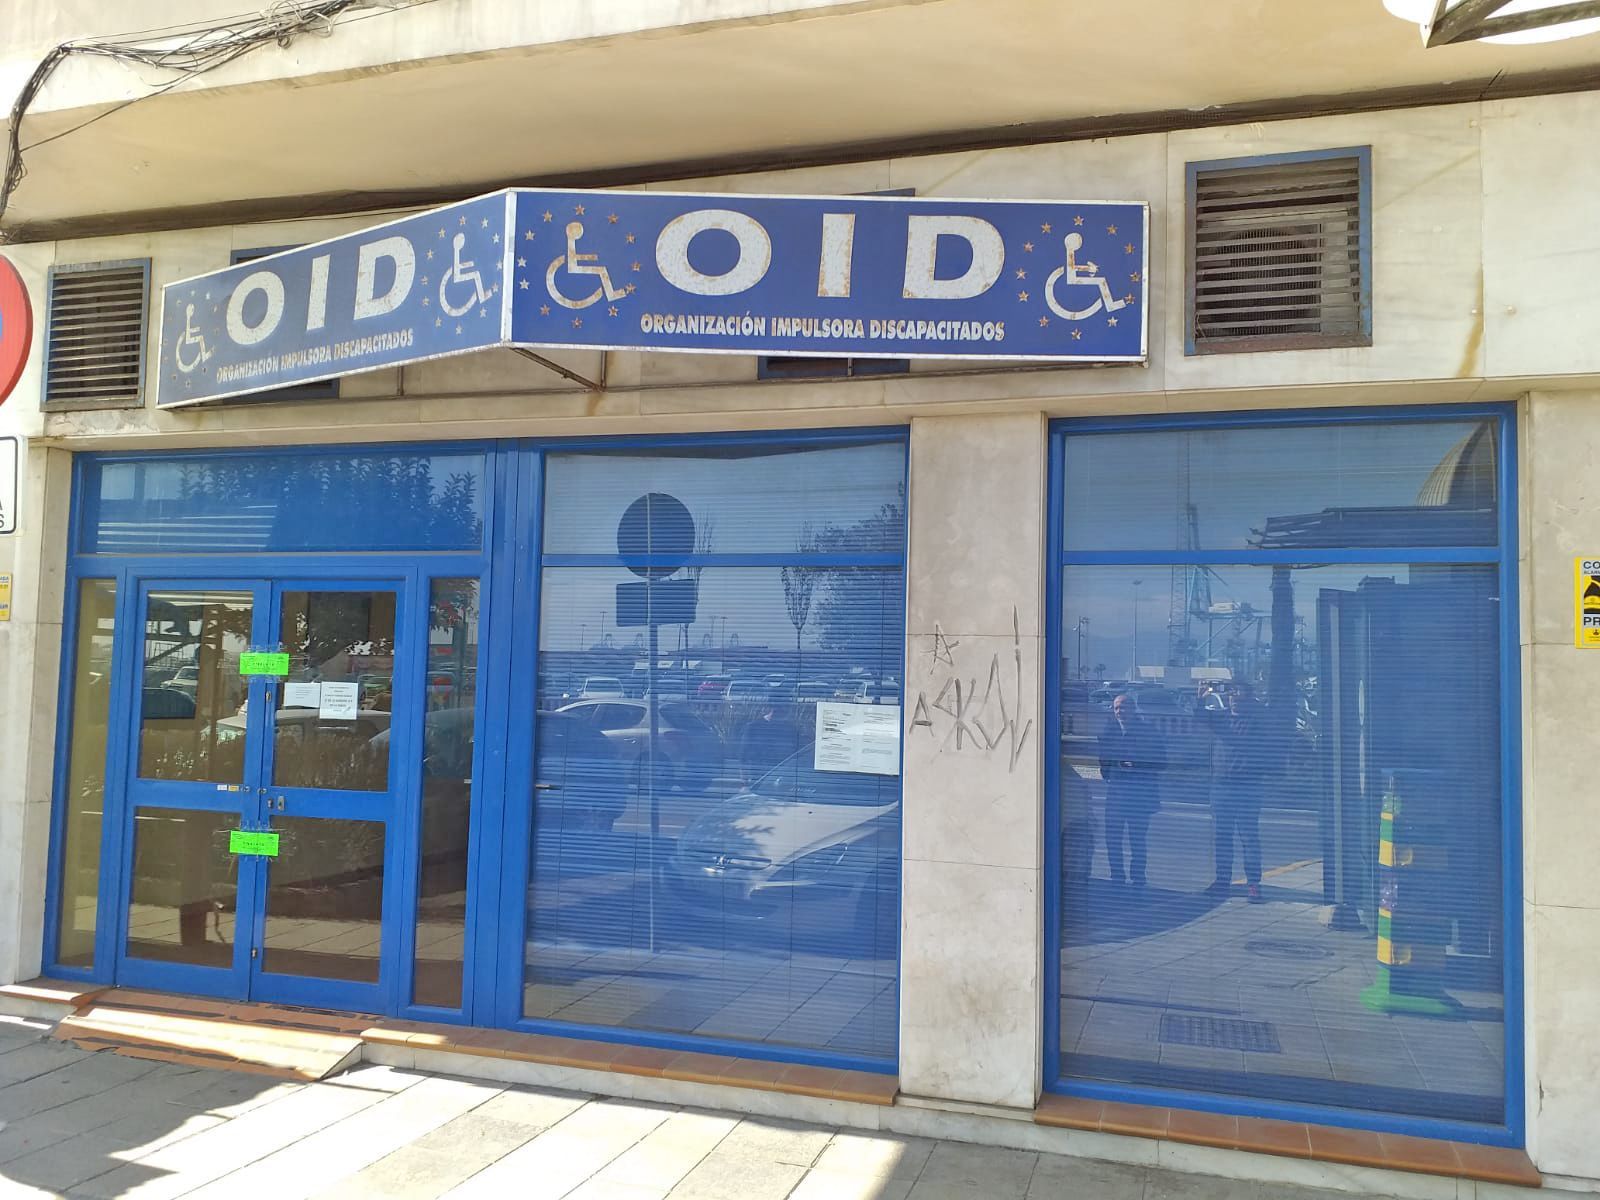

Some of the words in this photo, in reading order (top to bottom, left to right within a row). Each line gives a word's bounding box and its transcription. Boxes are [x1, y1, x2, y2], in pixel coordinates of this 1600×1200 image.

[226, 235, 416, 345] OID
[655, 209, 1005, 299] OID
[216, 351, 280, 384] ORGANIZACIÓN
[281, 345, 333, 370] IMPULSORA
[333, 328, 414, 360] DISCAPACITADOS
[641, 311, 766, 336] ORGANIZACIÓN
[771, 317, 865, 339] IMPULSORA
[869, 319, 1005, 342] DISCAPACITADOS
